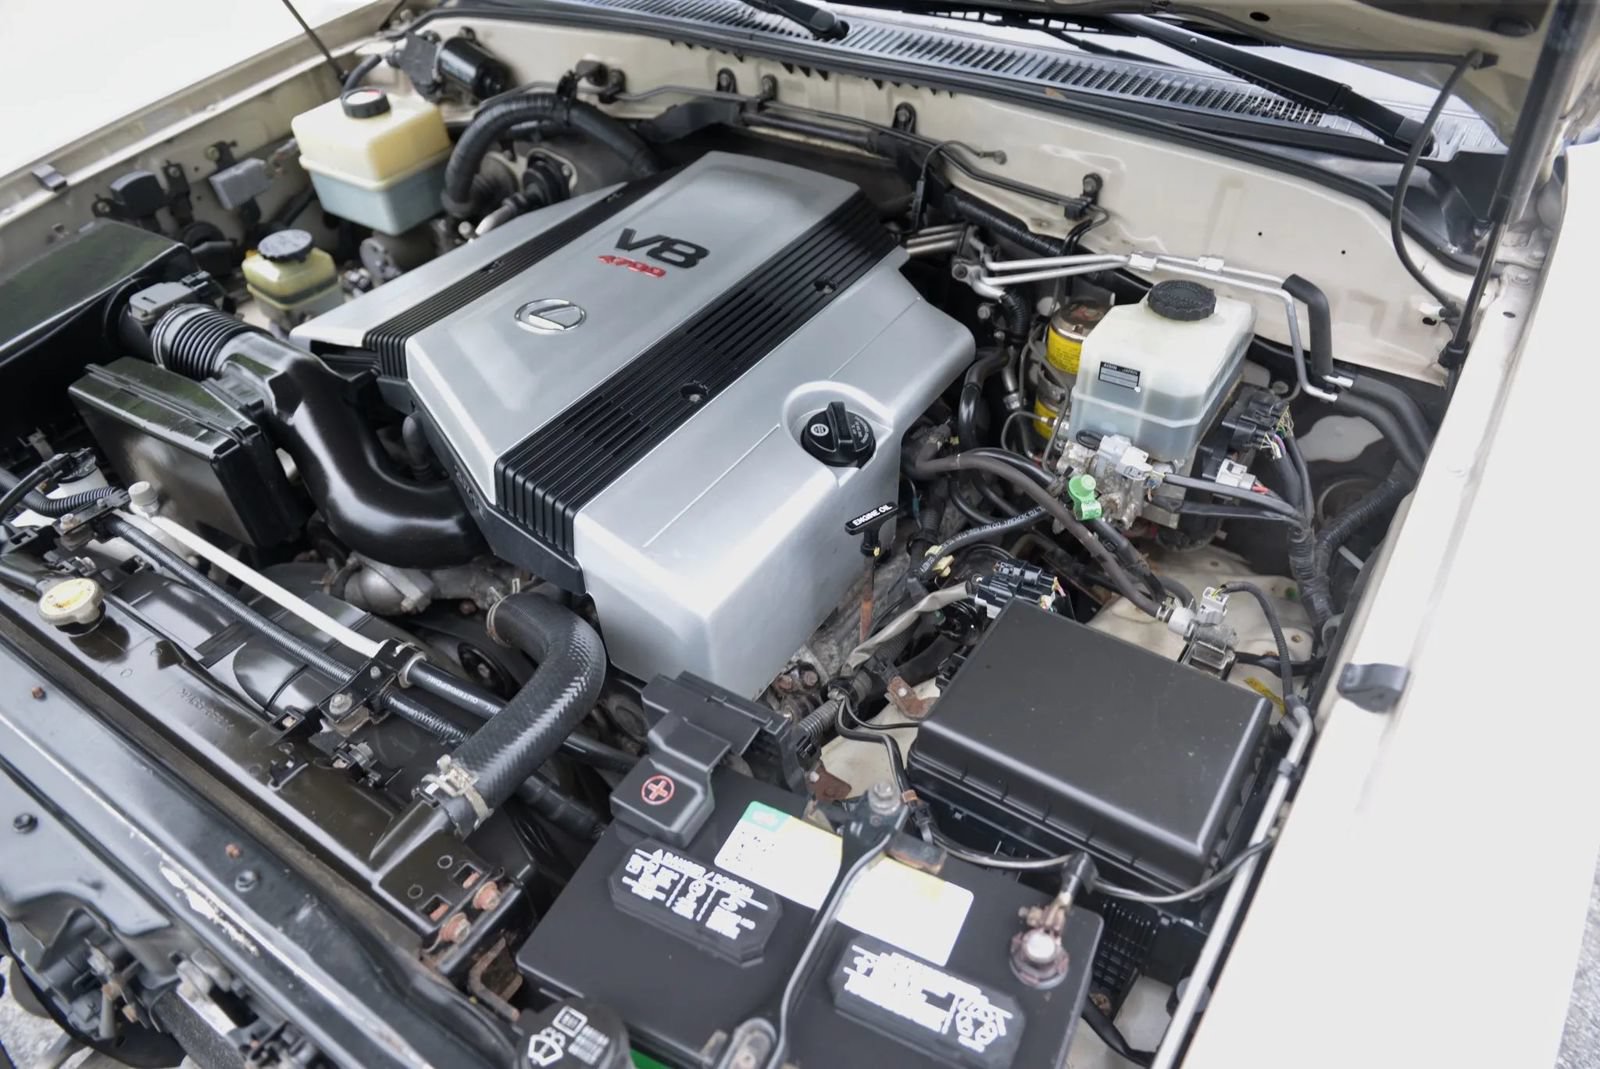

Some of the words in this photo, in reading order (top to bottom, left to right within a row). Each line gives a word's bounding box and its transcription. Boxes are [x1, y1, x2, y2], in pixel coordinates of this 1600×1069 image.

[615, 228, 710, 269] V8
[852, 509, 880, 526] ENGINE
[878, 504, 893, 513] OIL
